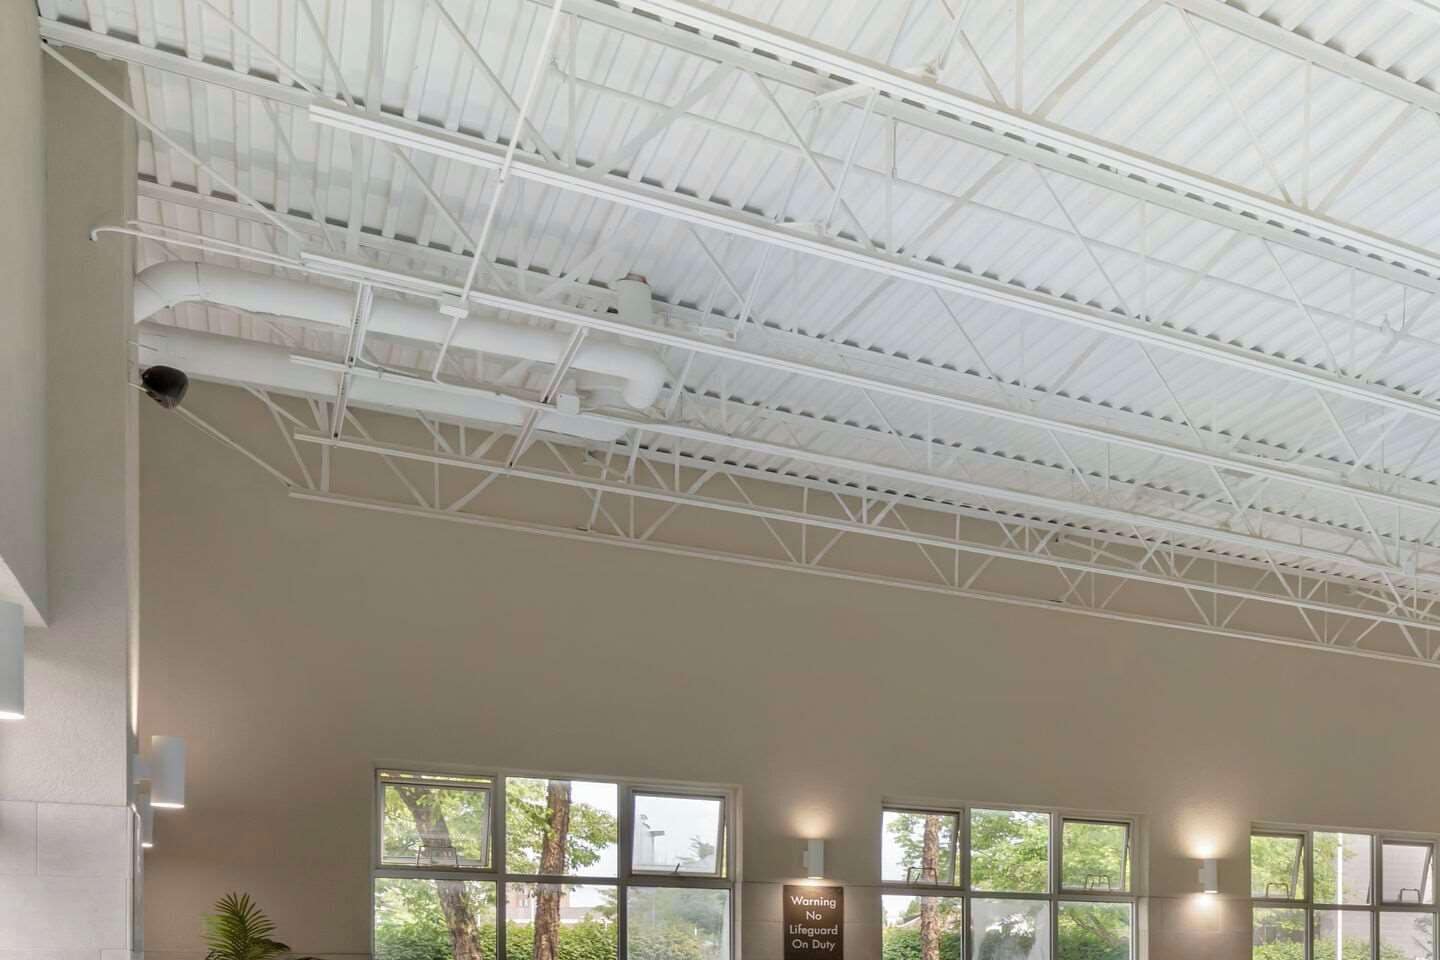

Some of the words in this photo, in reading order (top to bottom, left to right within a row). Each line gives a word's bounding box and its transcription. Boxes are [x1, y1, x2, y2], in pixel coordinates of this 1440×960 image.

[790, 895, 837, 909] Warning
[806, 911, 822, 920] No
[789, 923, 838, 937] Lifeguard
[791, 938, 809, 949] On
[812, 939, 836, 951] Duty
